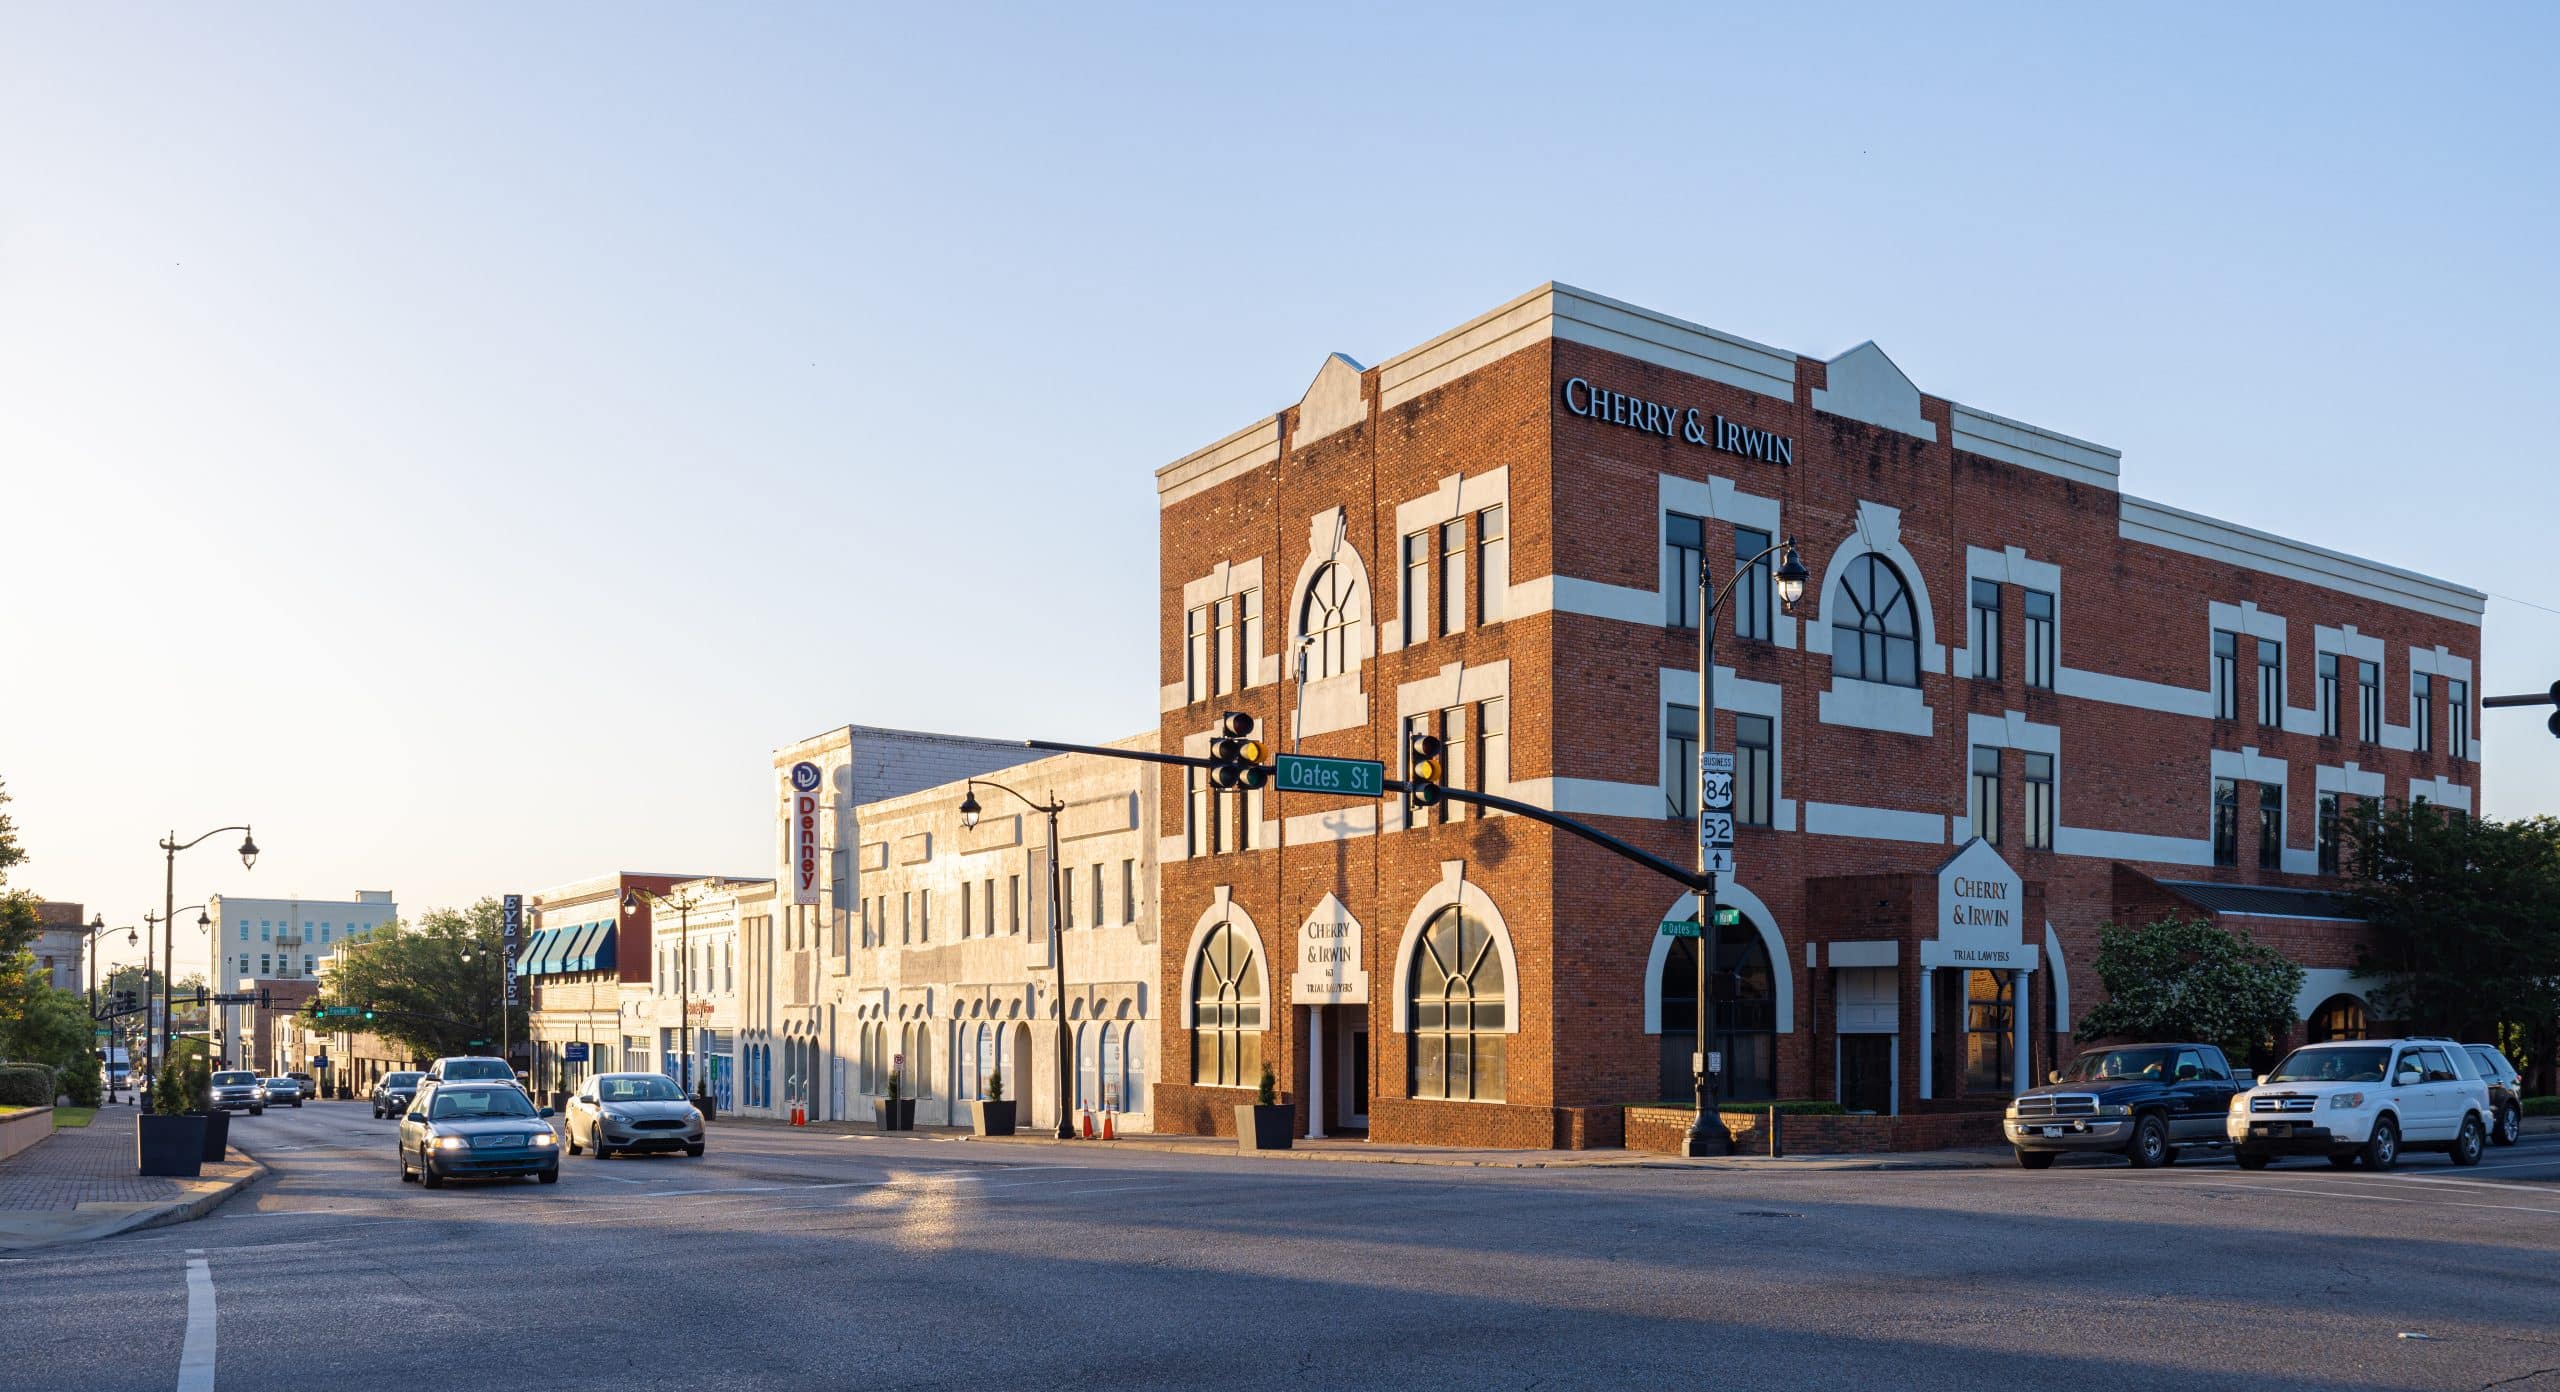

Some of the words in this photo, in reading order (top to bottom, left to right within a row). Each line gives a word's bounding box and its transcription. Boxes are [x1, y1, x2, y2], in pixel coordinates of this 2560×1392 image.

[1563, 376, 1679, 438] CHERRY
[1682, 407, 1708, 446] &
[1714, 414, 1794, 467] IRWIN
[1704, 757, 1731, 767] BUSINESS
[1291, 761, 1339, 788] Oates
[1351, 766, 1369, 789] St
[1707, 780, 1730, 801] 84
[1705, 818, 1730, 839] 52
[799, 796, 815, 890] Denney
[1954, 876, 2008, 899] CHERRY
[504, 896, 519, 937] EYE
[1953, 904, 1966, 925] &
[1968, 905, 2009, 928] IRWIN
[1308, 922, 1349, 939] CHERRY
[1307, 945, 1317, 963] &
[1319, 945, 1351, 963] IRWIN
[1953, 949, 1976, 961] TRIAL
[1978, 950, 2010, 962] LAWYERS
[505, 944, 518, 999] CARE
[1306, 983, 1325, 993] TRIAL
[1326, 983, 1353, 993] LAWYERS
